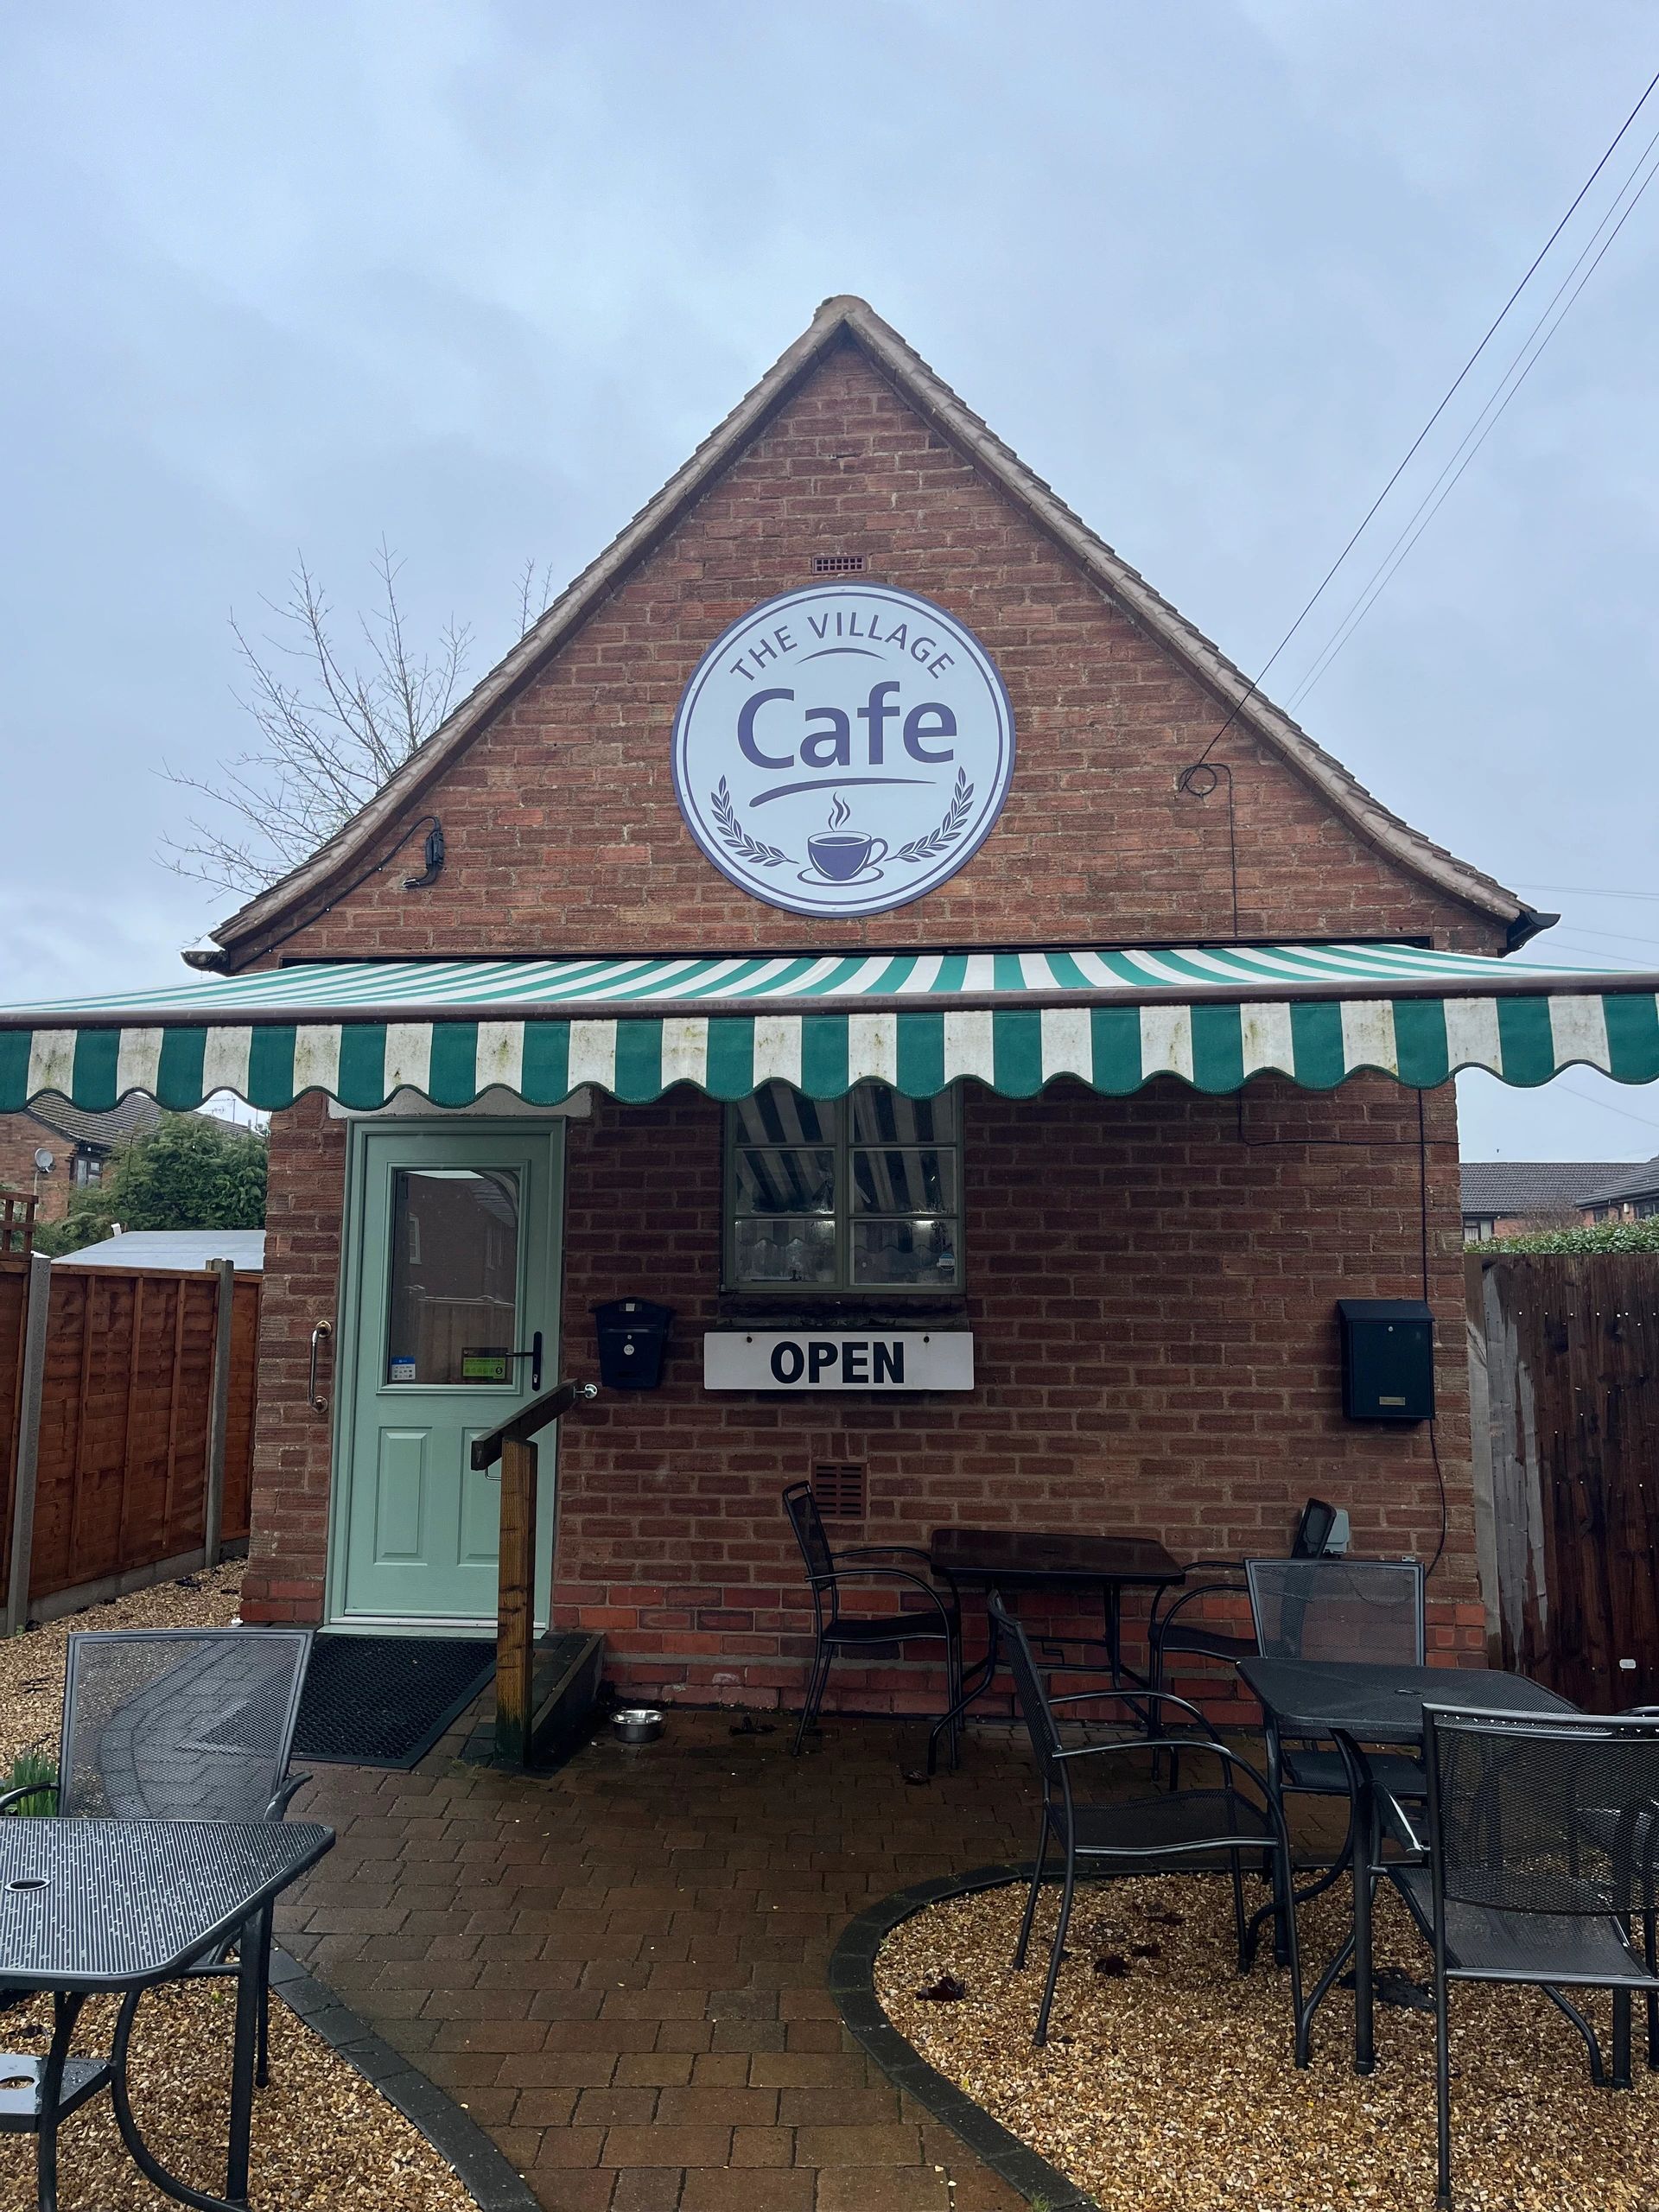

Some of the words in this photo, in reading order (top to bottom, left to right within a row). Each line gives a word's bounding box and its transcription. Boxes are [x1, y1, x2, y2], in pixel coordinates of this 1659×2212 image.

[729, 625, 798, 681] THE
[807, 612, 956, 679] VILLAGE
[737, 681, 957, 769] Cafe
[770, 1341, 905, 1384] OPEN
